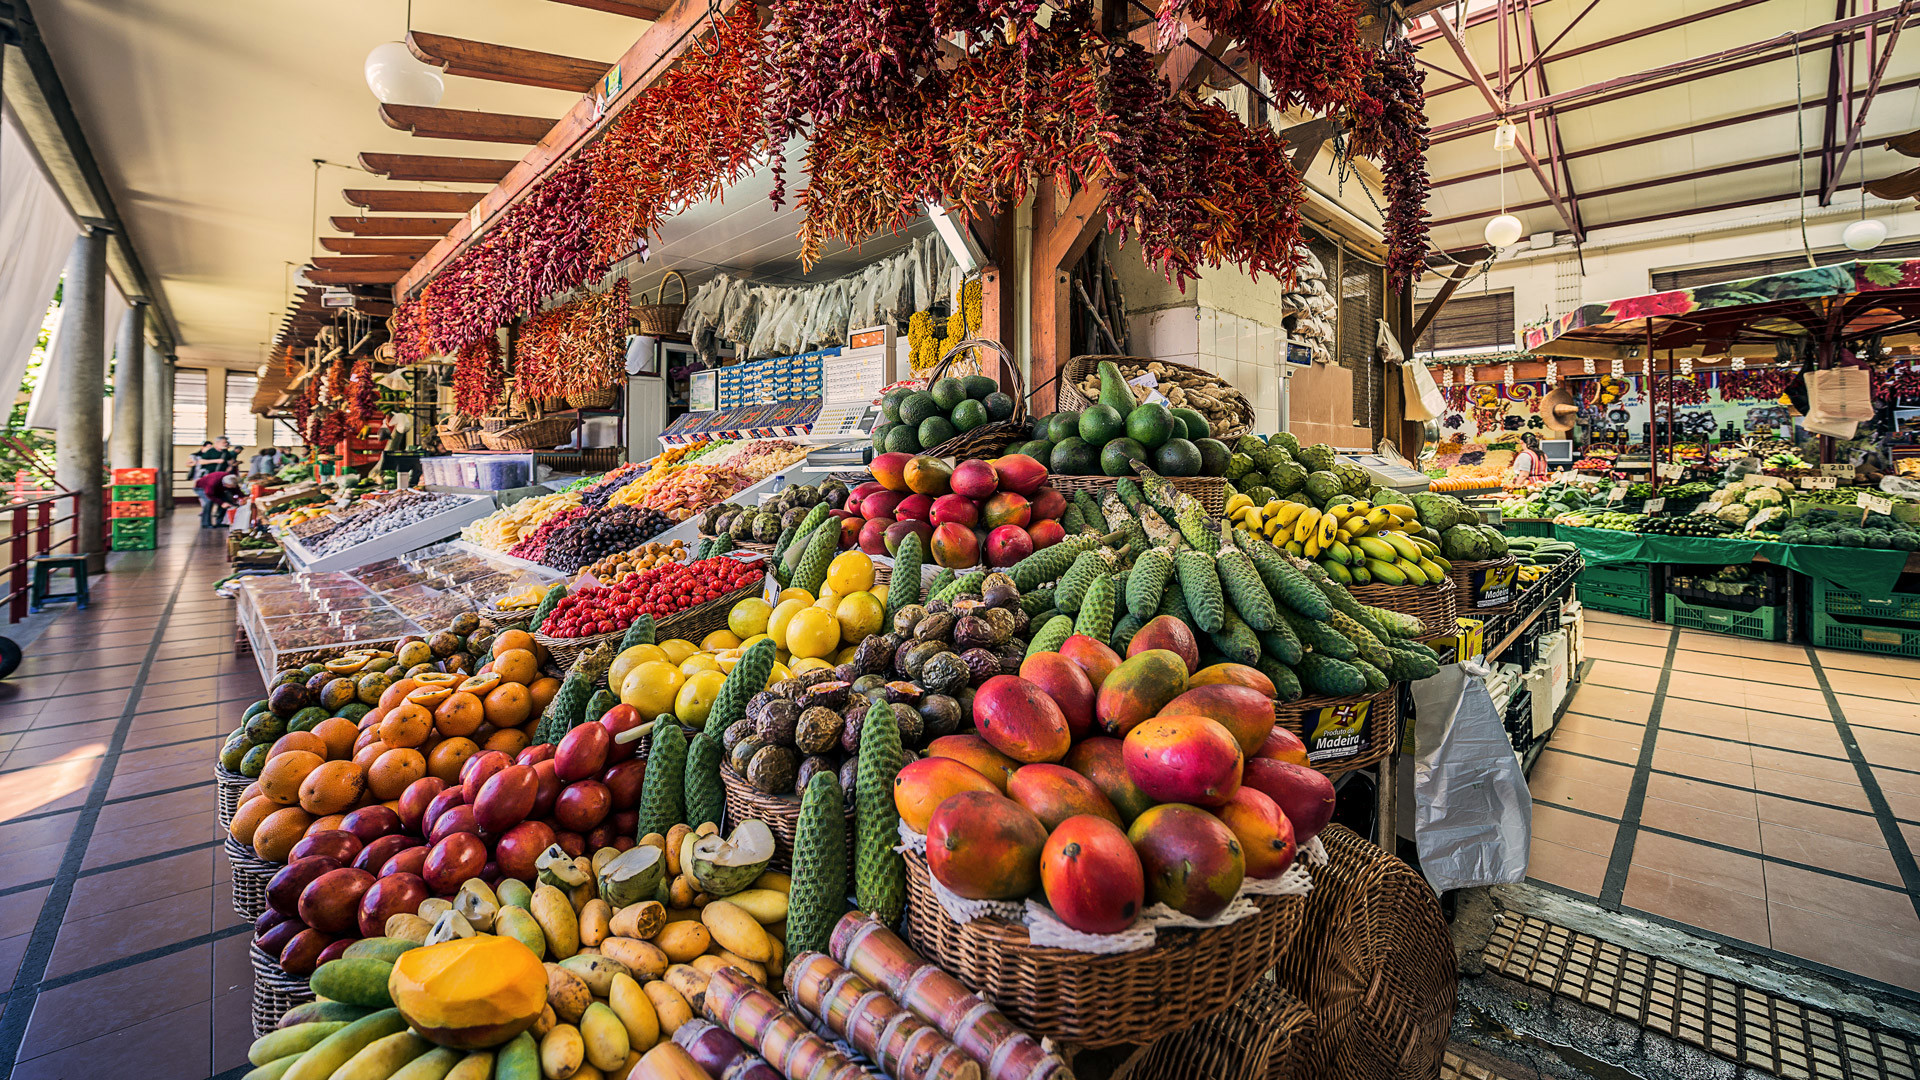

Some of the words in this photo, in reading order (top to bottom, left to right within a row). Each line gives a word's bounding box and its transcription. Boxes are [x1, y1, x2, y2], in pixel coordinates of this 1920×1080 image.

[1485, 588, 1509, 600] Madeira
[1323, 729, 1347, 737] Produto
[1316, 734, 1360, 750] Madeira
